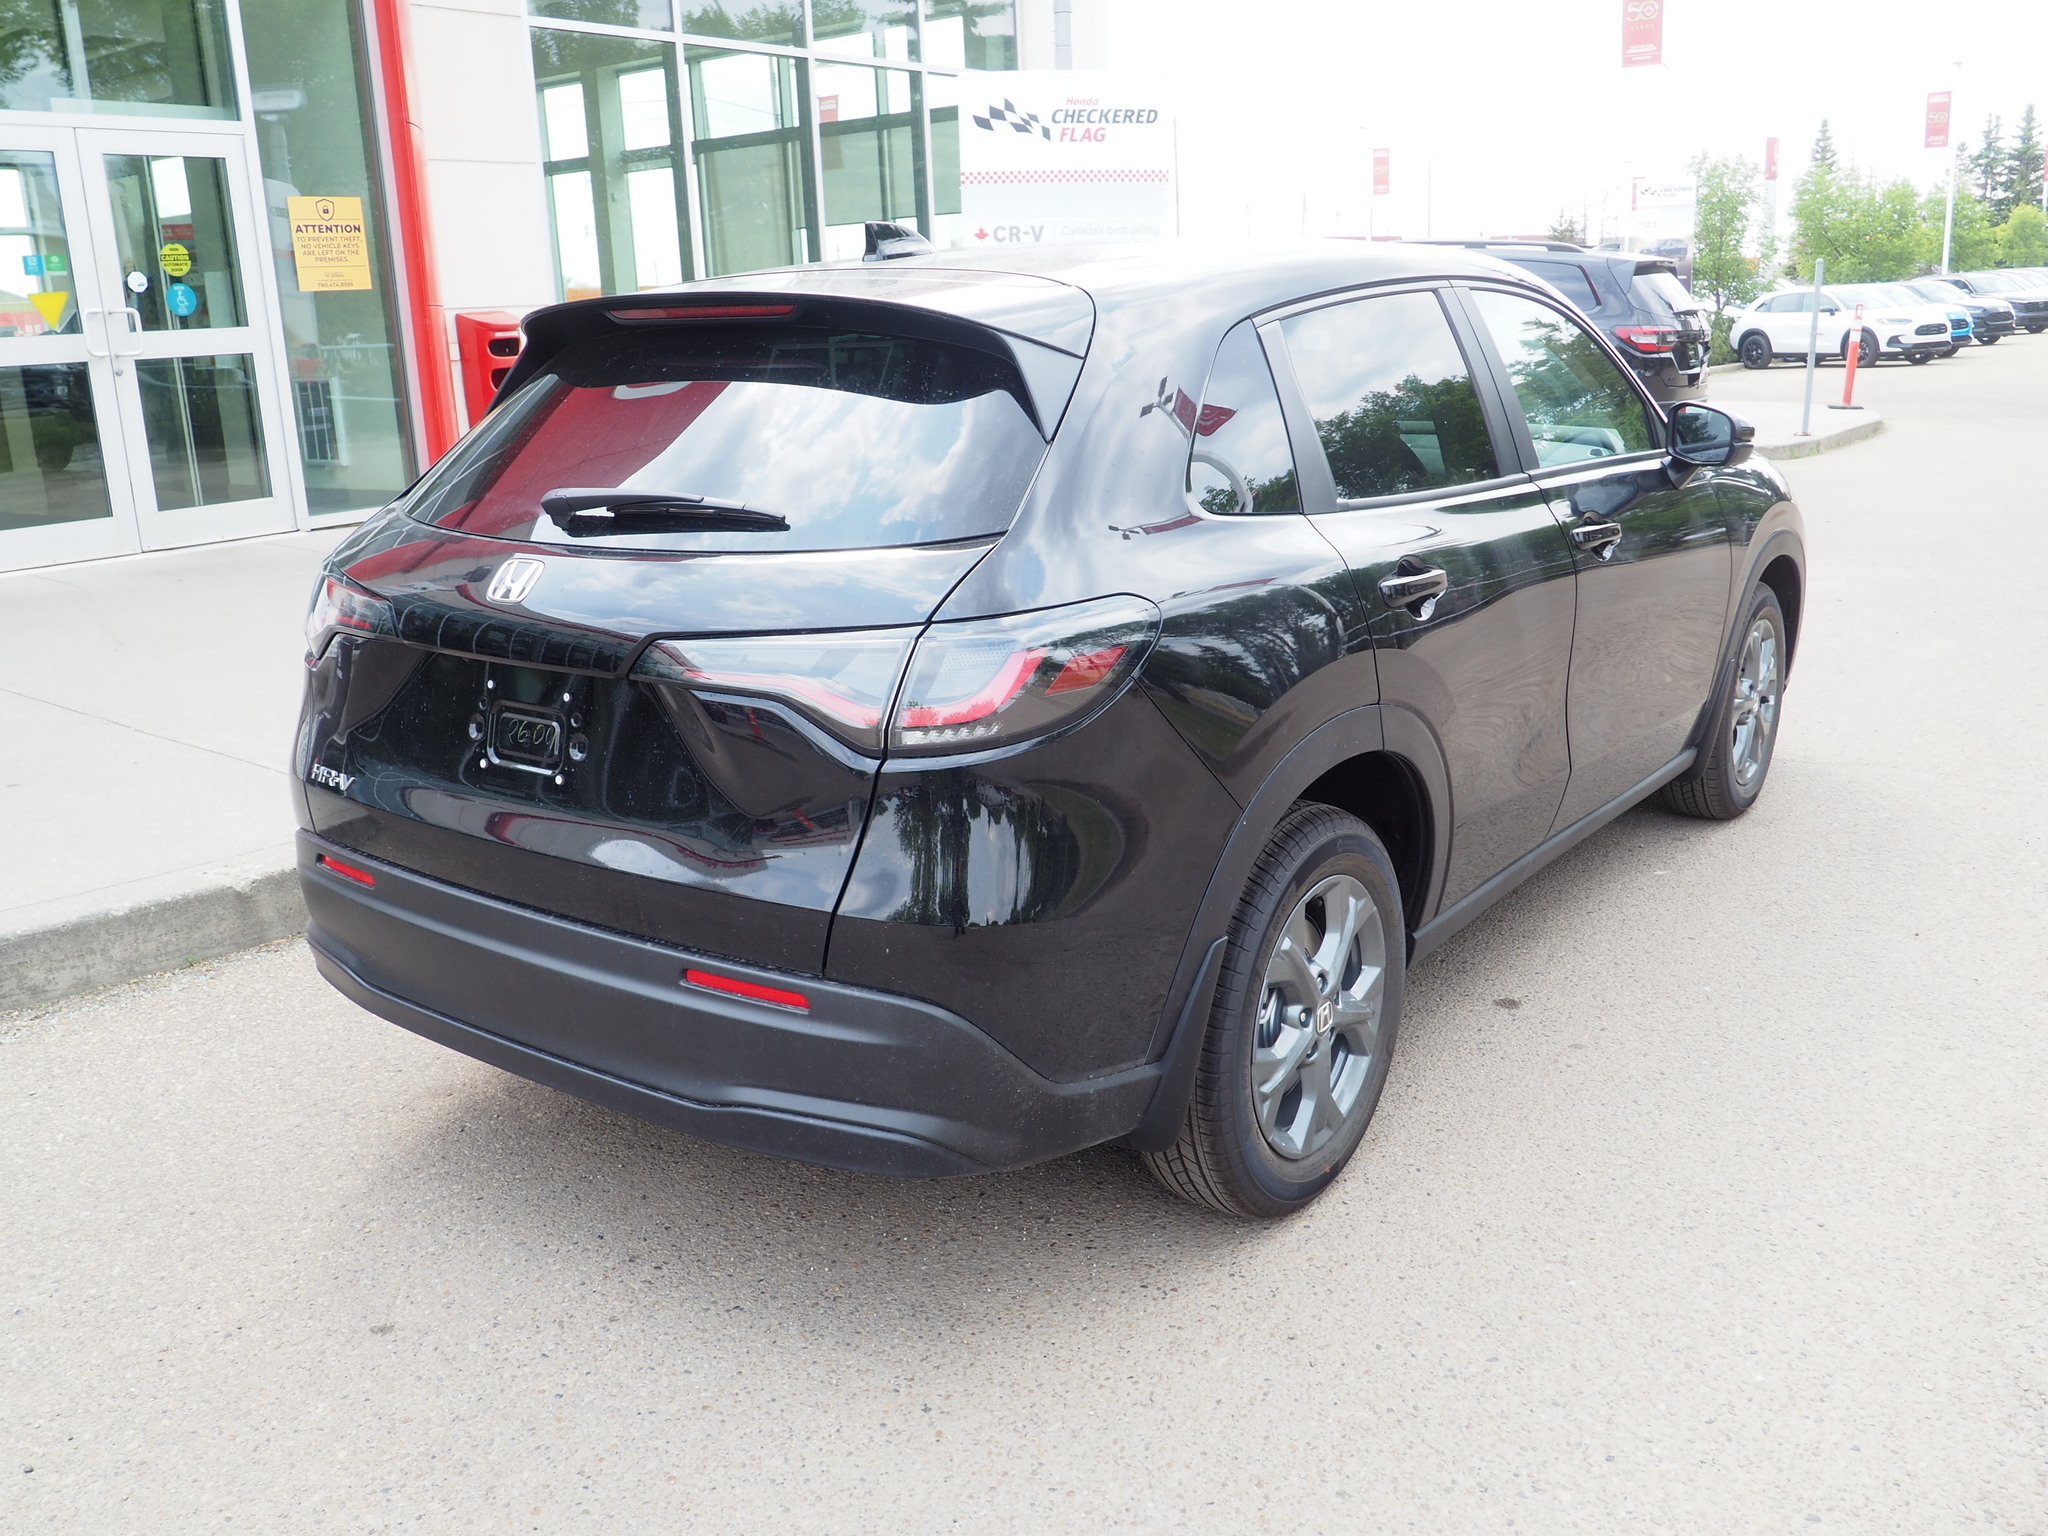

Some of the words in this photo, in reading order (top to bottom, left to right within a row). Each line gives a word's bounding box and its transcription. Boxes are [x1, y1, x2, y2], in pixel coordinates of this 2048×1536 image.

[1066, 97, 1099, 106] Honda
[1051, 108, 1158, 124] CHECKERED
[1059, 127, 1107, 142] FLAG
[295, 224, 361, 233] ATTENTION
[993, 225, 1044, 243] CR-V
[1061, 225, 1105, 237] Canada's
